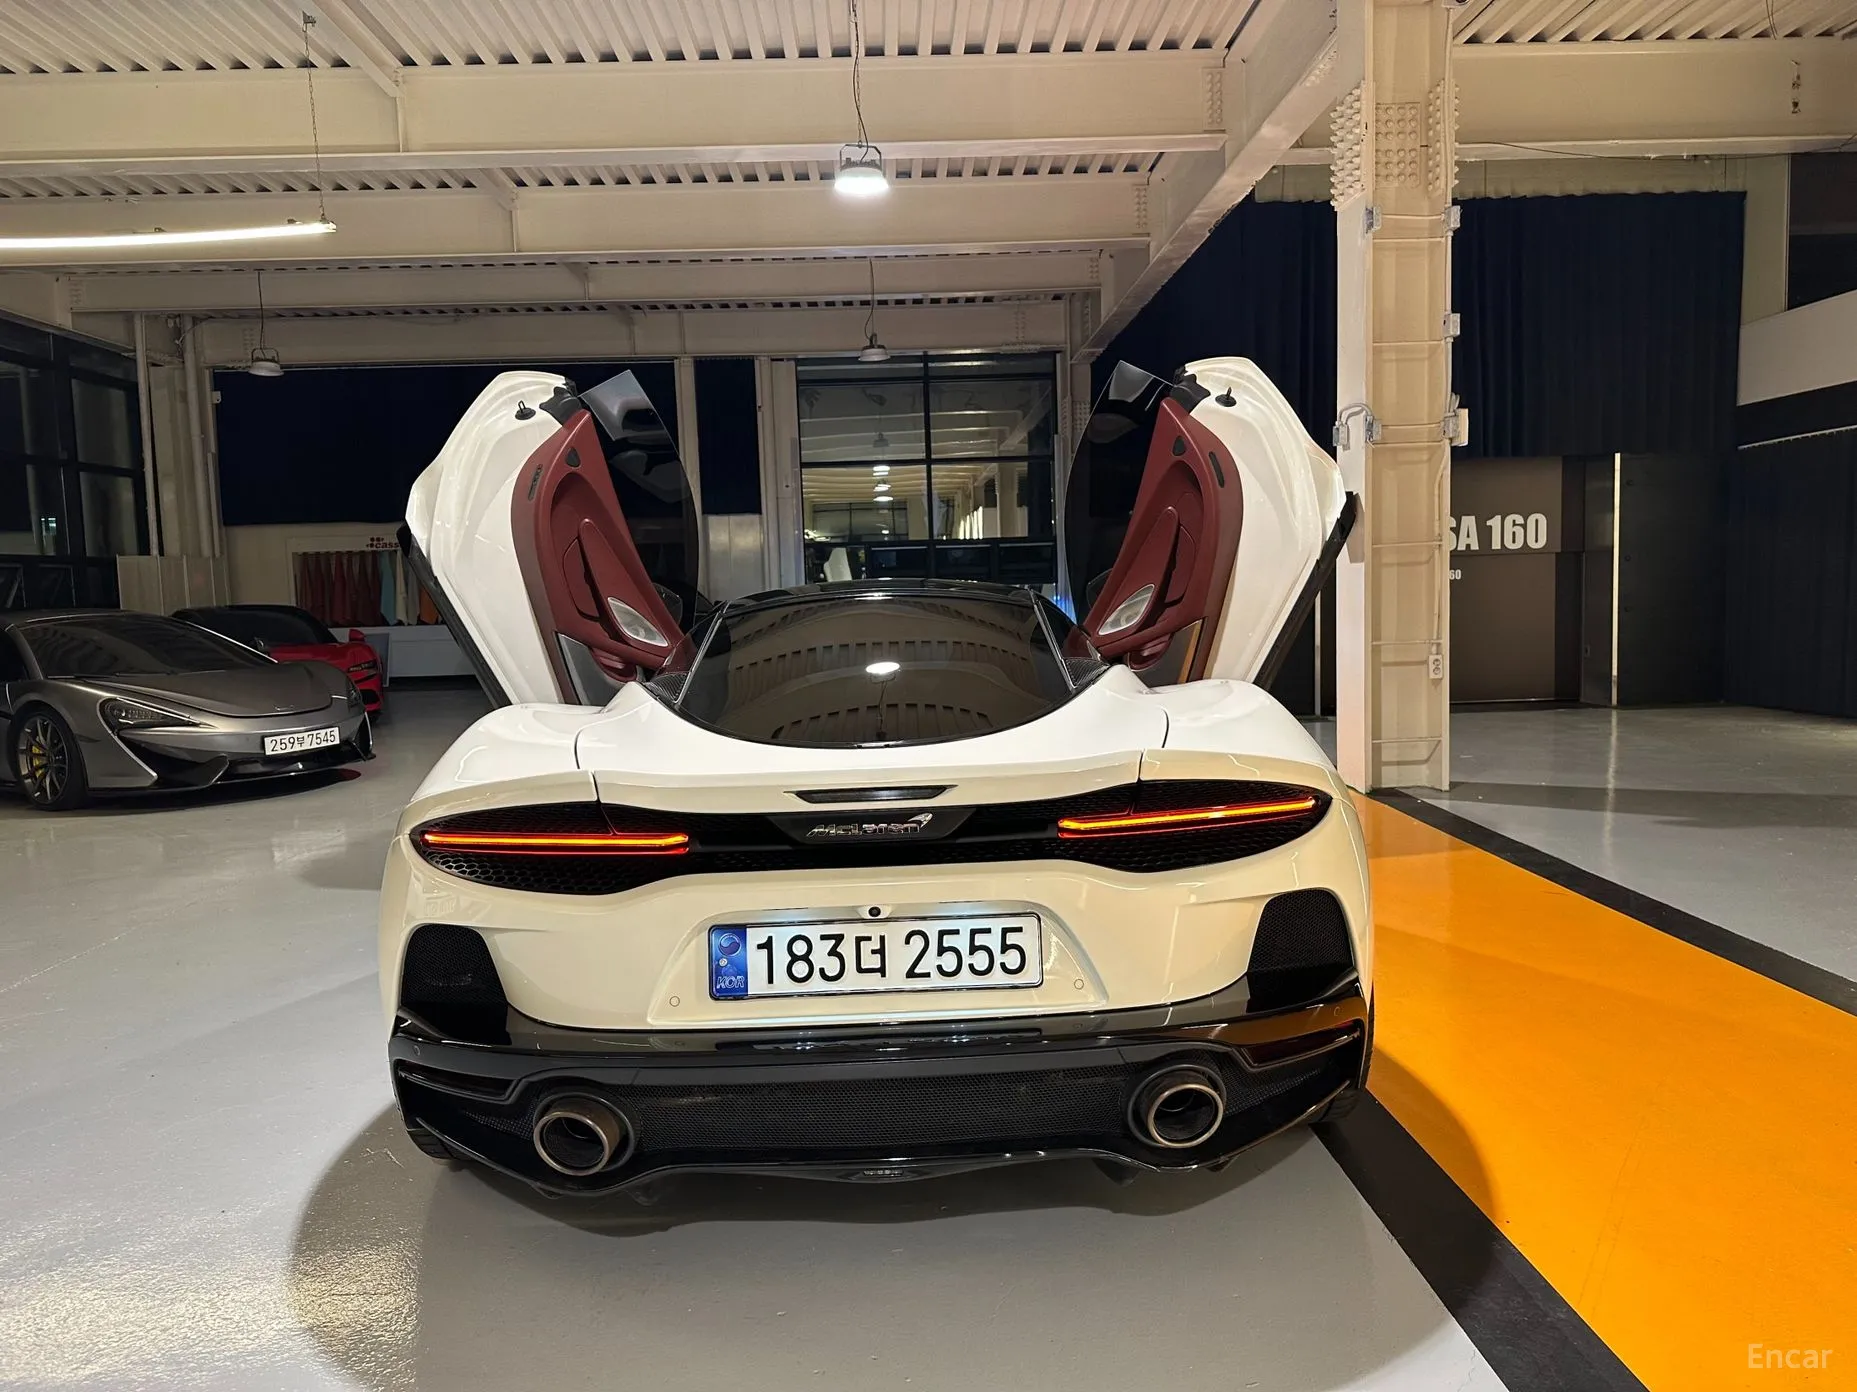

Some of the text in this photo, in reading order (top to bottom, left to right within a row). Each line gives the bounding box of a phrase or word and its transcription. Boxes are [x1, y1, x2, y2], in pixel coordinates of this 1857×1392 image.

[1486, 513, 1547, 550] 160
[270, 730, 336, 753] 259부 7545
[806, 822, 920, 838] McLaren
[756, 926, 1027, 985] 183더 2555
[716, 975, 746, 989] KOR
